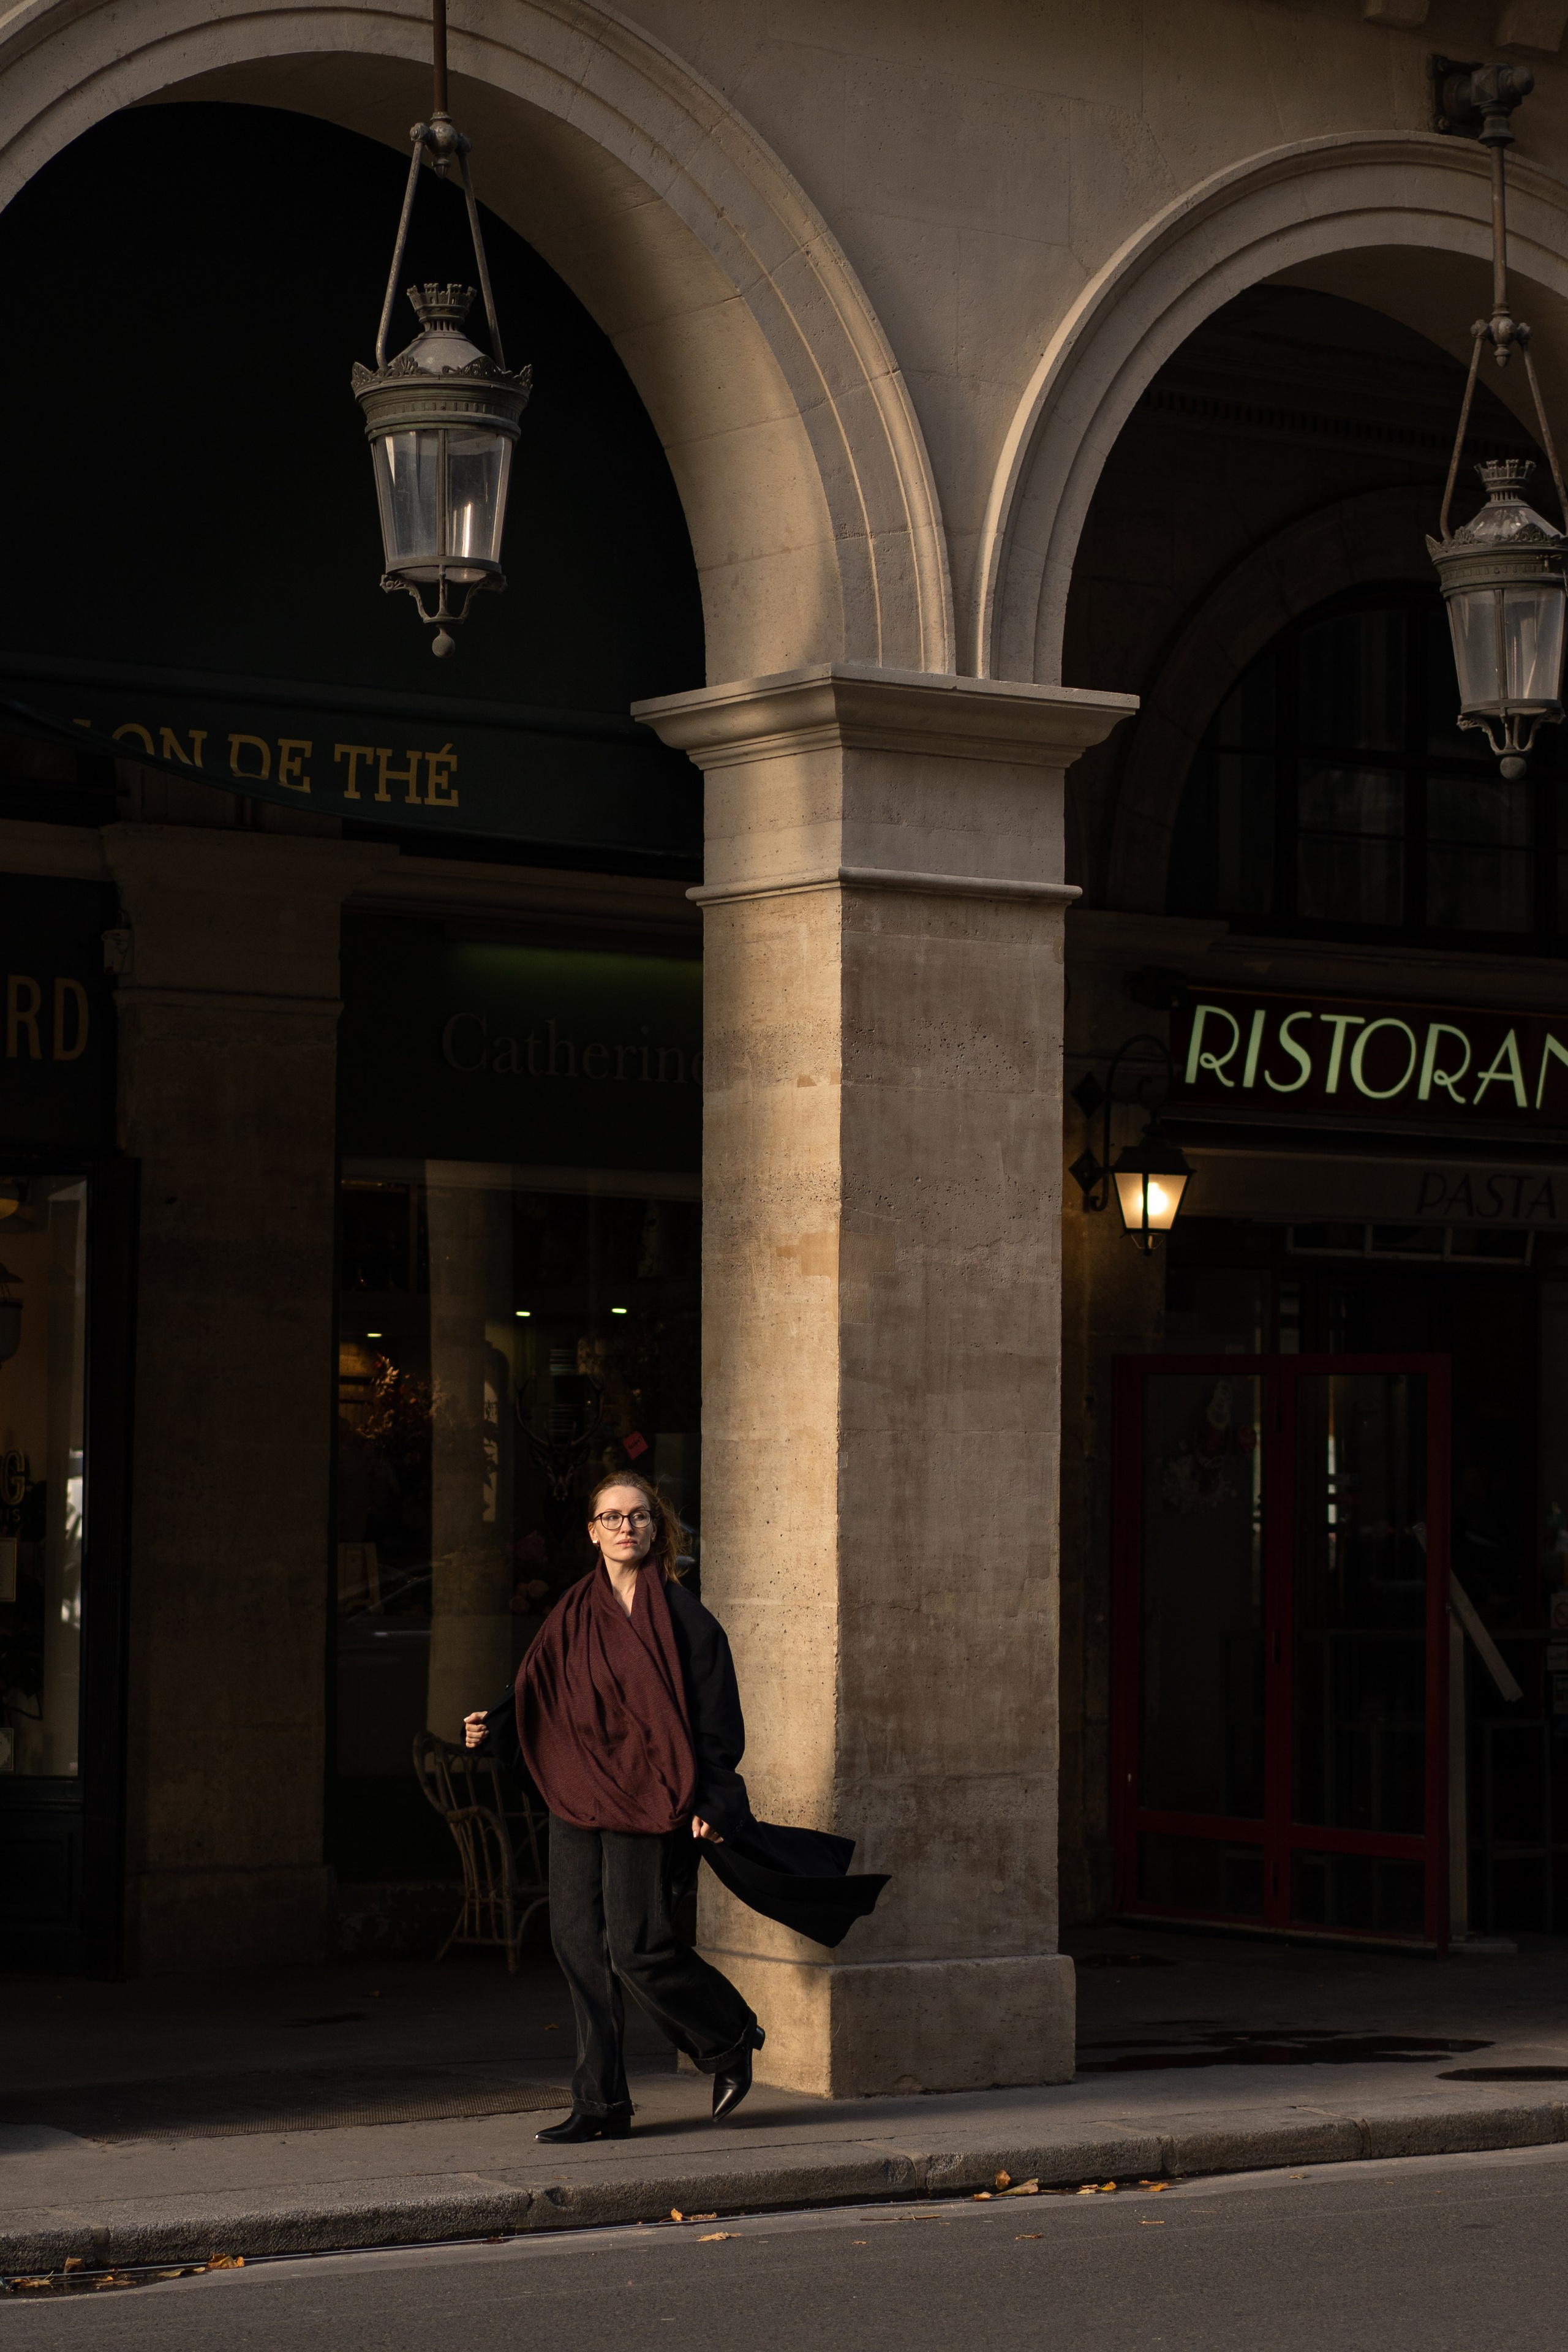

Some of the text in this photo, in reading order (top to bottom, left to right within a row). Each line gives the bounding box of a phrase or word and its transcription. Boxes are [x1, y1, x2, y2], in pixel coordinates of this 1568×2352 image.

[227, 734, 312, 794] DE
[334, 743, 459, 807] THÉ
[6, 973, 90, 1061] RD
[1416, 1171, 1556, 1219] PASTA
